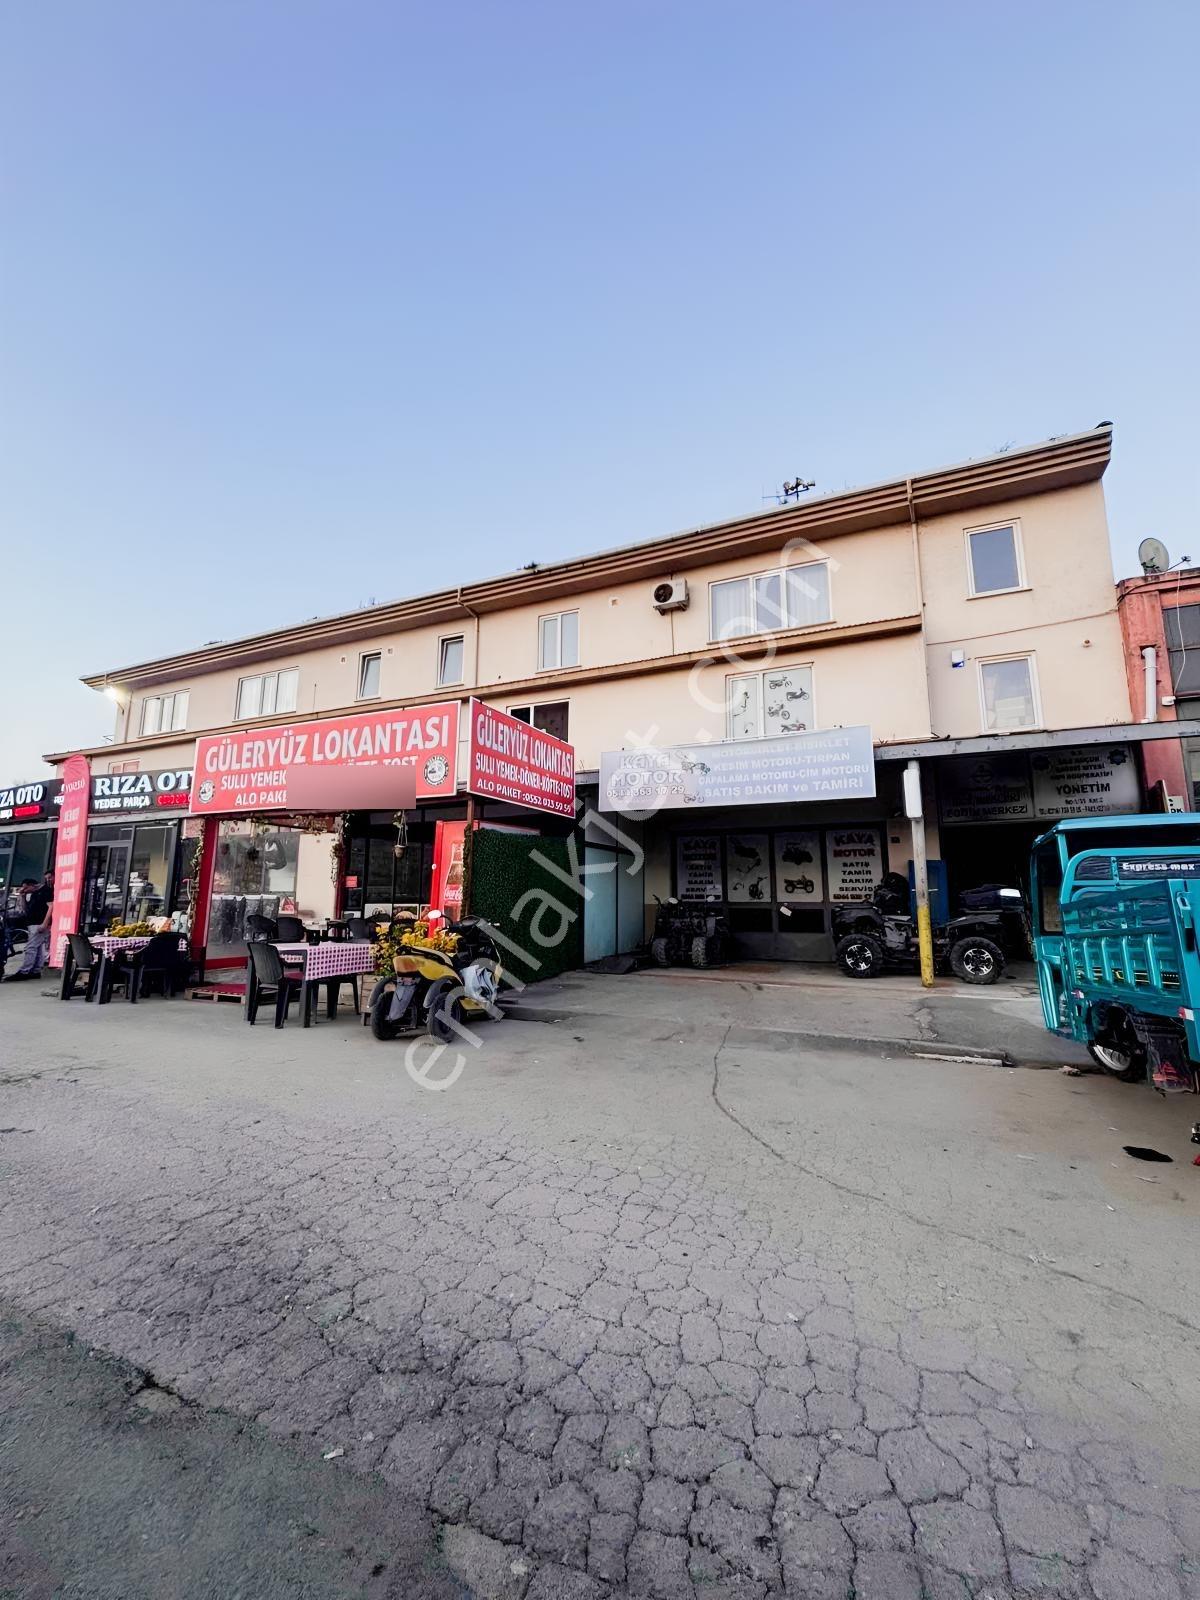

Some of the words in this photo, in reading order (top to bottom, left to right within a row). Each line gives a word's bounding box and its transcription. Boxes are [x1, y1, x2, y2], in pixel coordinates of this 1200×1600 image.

[205, 729, 309, 773] GÜLERYÜZ
[311, 714, 449, 762] LOKANTASI
[477, 709, 528, 763] GÜLERYÜZ
[529, 736, 574, 780] LOKANTASI
[476, 752, 495, 774] SULU
[94, 774, 153, 796] RIZA
[220, 773, 248, 790] SULU
[250, 769, 287, 788] YEMEK
[610, 769, 684, 787] MOTOR
[16, 784, 43, 805] OTO
[477, 778, 494, 792] ALO
[496, 783, 522, 800] PAKET
[744, 783, 789, 795] BAKIM
[94, 797, 122, 809] YEDEK
[122, 795, 150, 809] PARÇA
[235, 792, 257, 806] ALO
[834, 832, 875, 846] KAYA
[833, 848, 876, 858] MOTOR
[1122, 862, 1168, 872] Express
[1170, 863, 1195, 871] max
